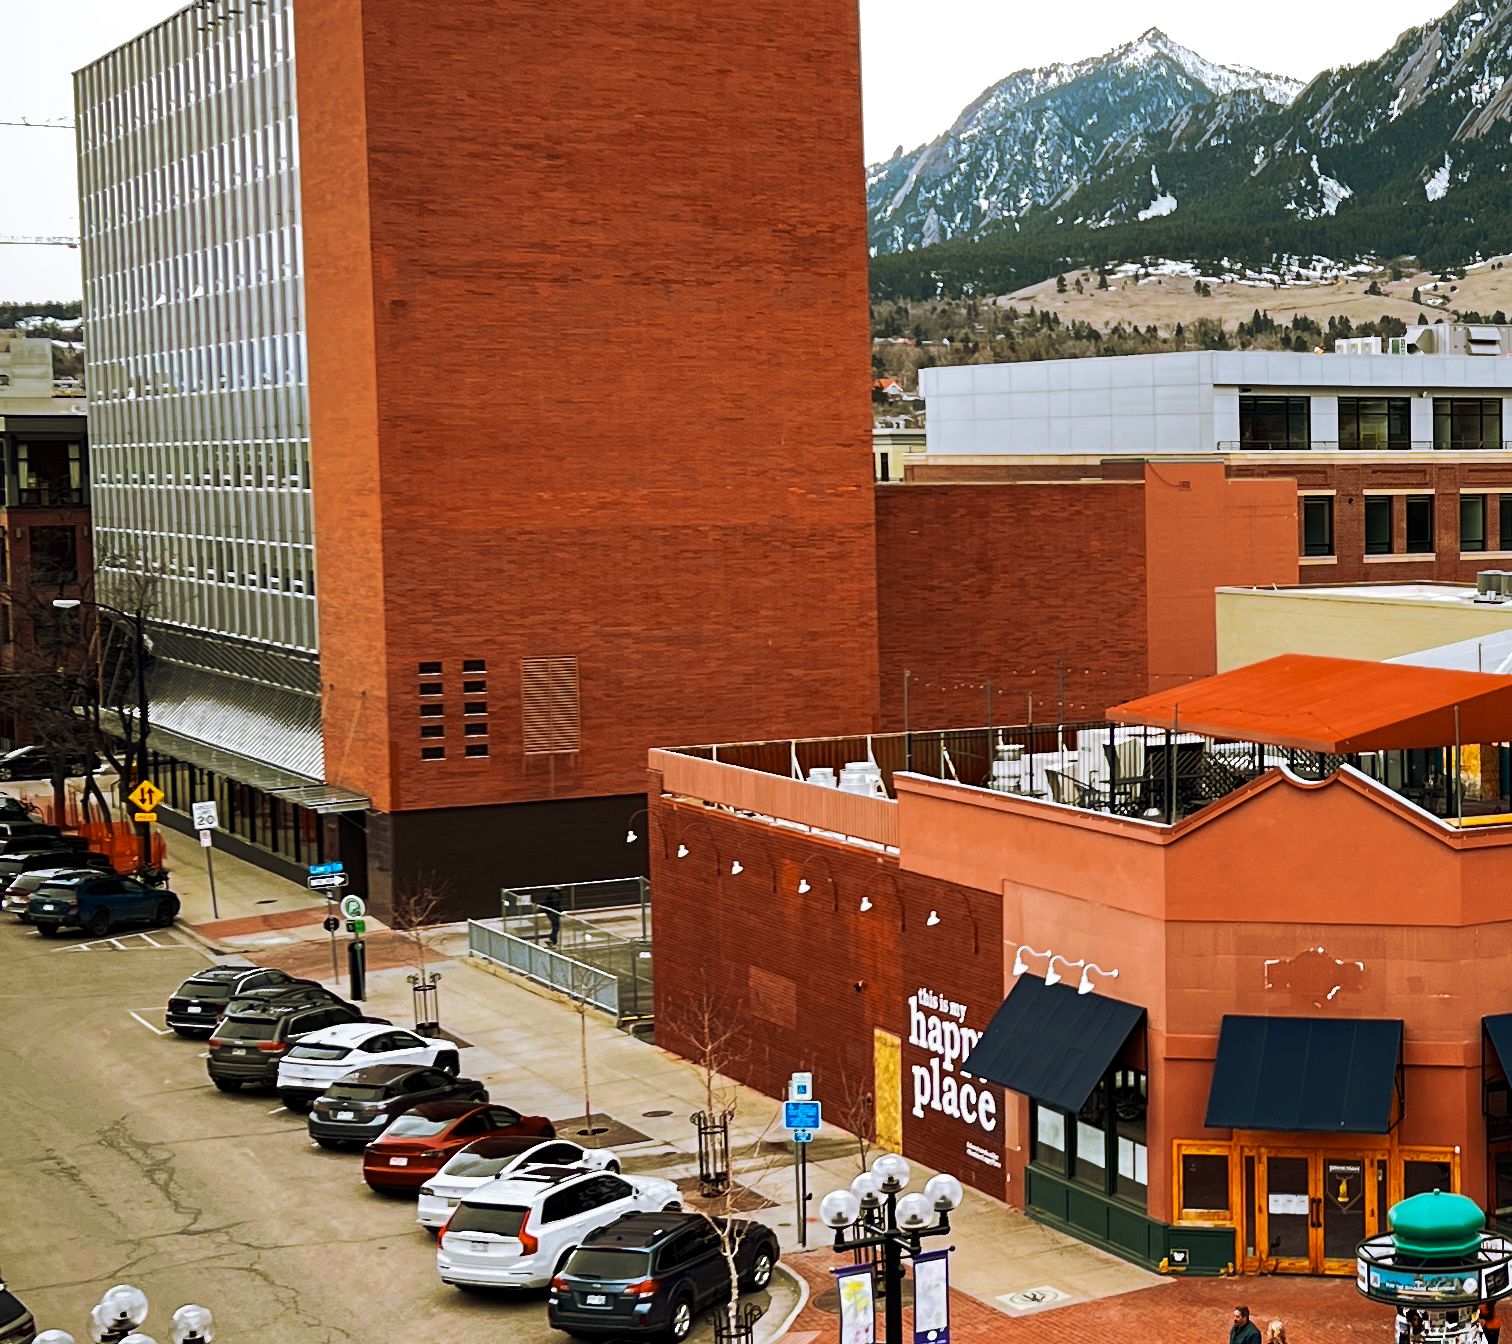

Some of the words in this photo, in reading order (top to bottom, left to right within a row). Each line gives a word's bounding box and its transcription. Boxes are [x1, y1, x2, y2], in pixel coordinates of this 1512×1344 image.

[197, 815, 214, 825] 20
[918, 987, 939, 1010] this
[939, 992, 949, 1013] is
[949, 1001, 967, 1024] my
[908, 995, 987, 1083] happ
[911, 1057, 997, 1132] place
